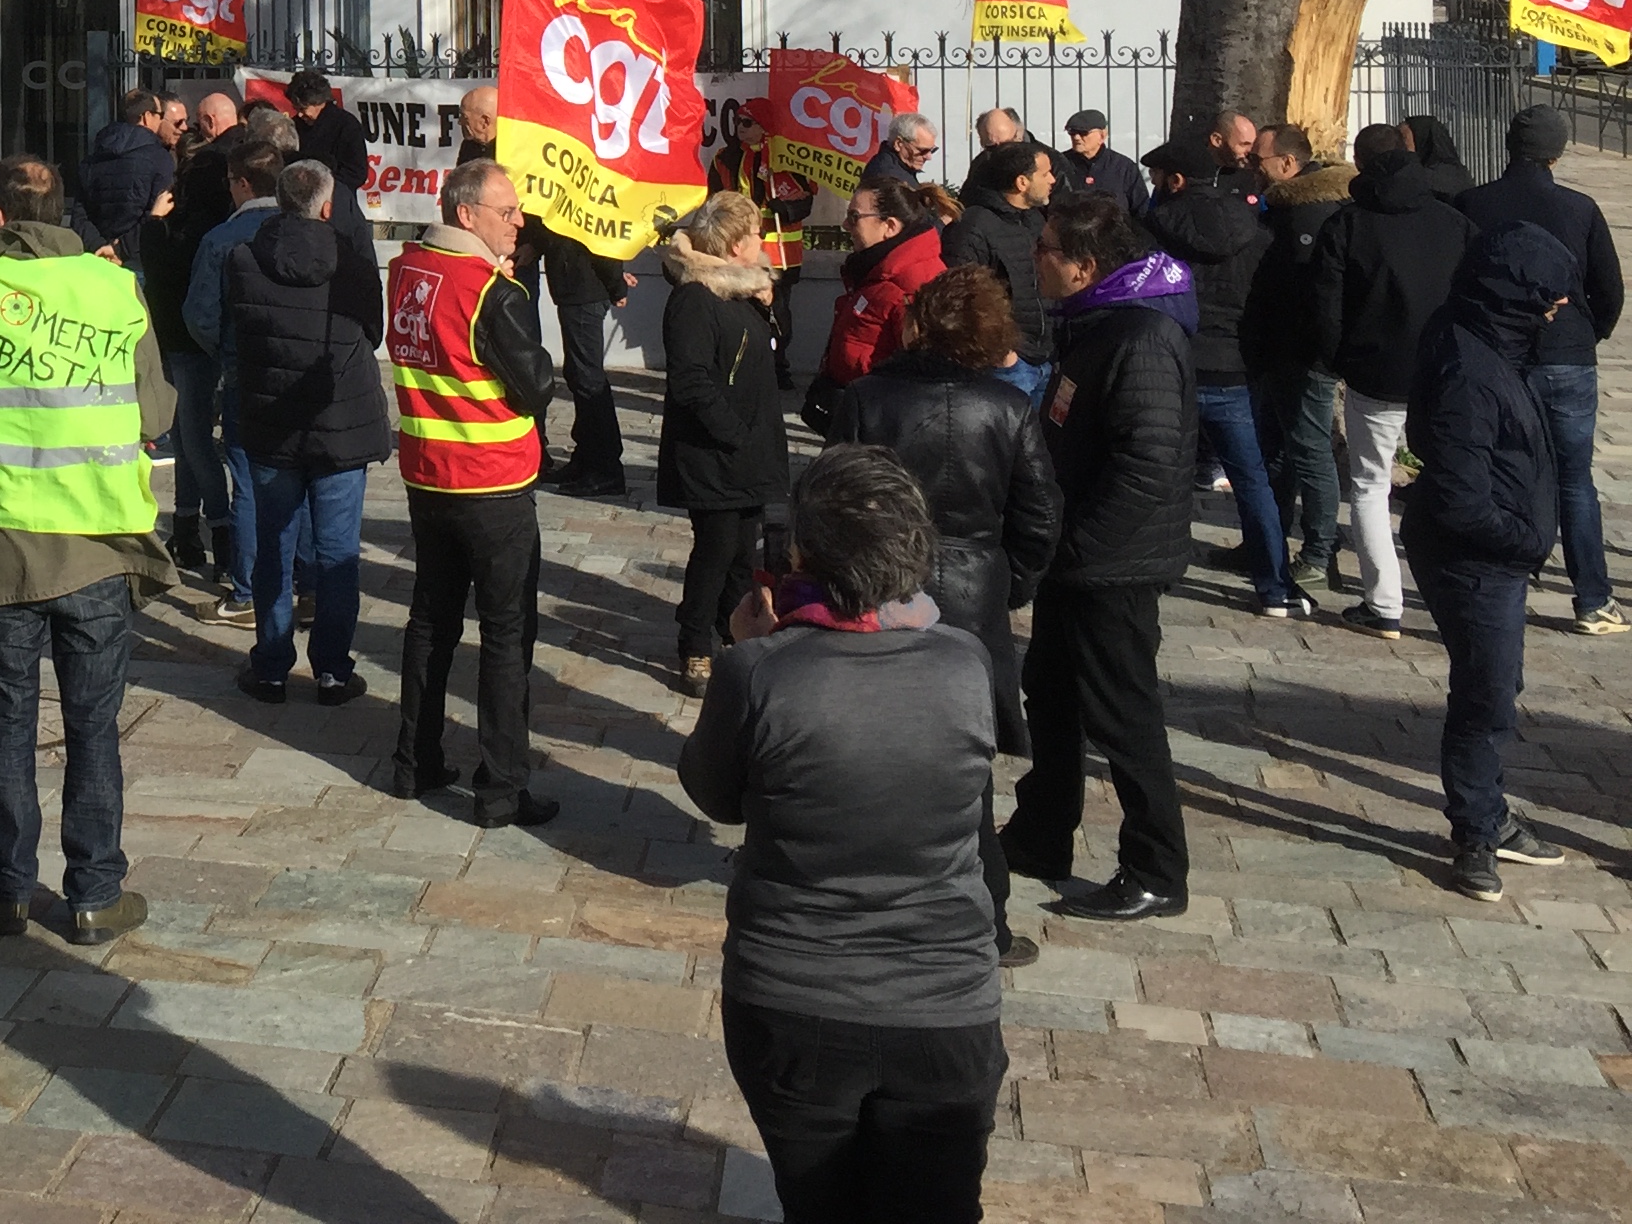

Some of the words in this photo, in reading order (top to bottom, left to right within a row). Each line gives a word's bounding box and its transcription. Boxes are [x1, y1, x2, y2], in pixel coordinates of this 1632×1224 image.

[985, 4, 1048, 21] CORSICA
[540, 14, 672, 160] cgt
[357, 101, 427, 148] UNE
[790, 86, 894, 155] cgt
[541, 141, 620, 209] CORSICA
[777, 154, 815, 176] TUTTI
[786, 142, 865, 180] CORSICA
[393, 310, 430, 346] cgt
